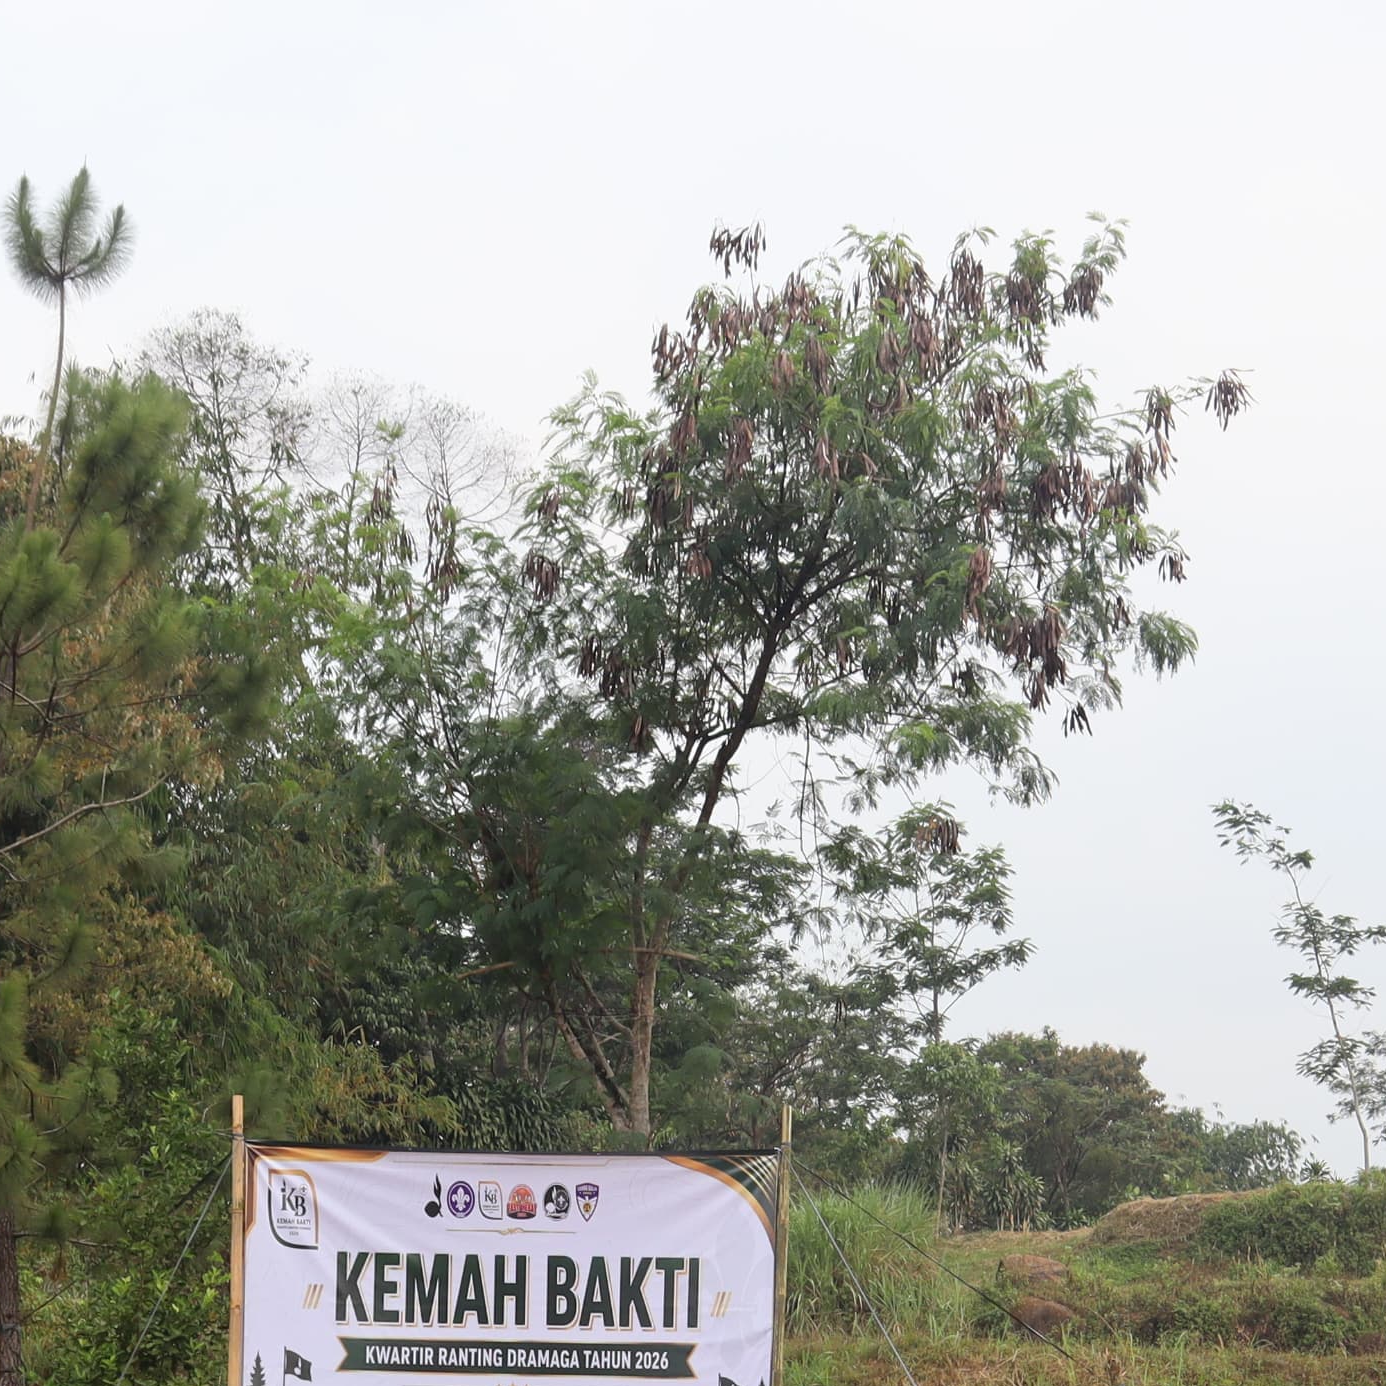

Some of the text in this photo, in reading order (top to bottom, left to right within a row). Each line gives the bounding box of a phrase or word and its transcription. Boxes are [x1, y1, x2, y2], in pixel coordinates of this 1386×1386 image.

[334, 1250, 702, 1331] KEMAH BAKTI
[365, 1345, 669, 1371] KWARTIR RANTING DRAMAGA TAHUN 2026
